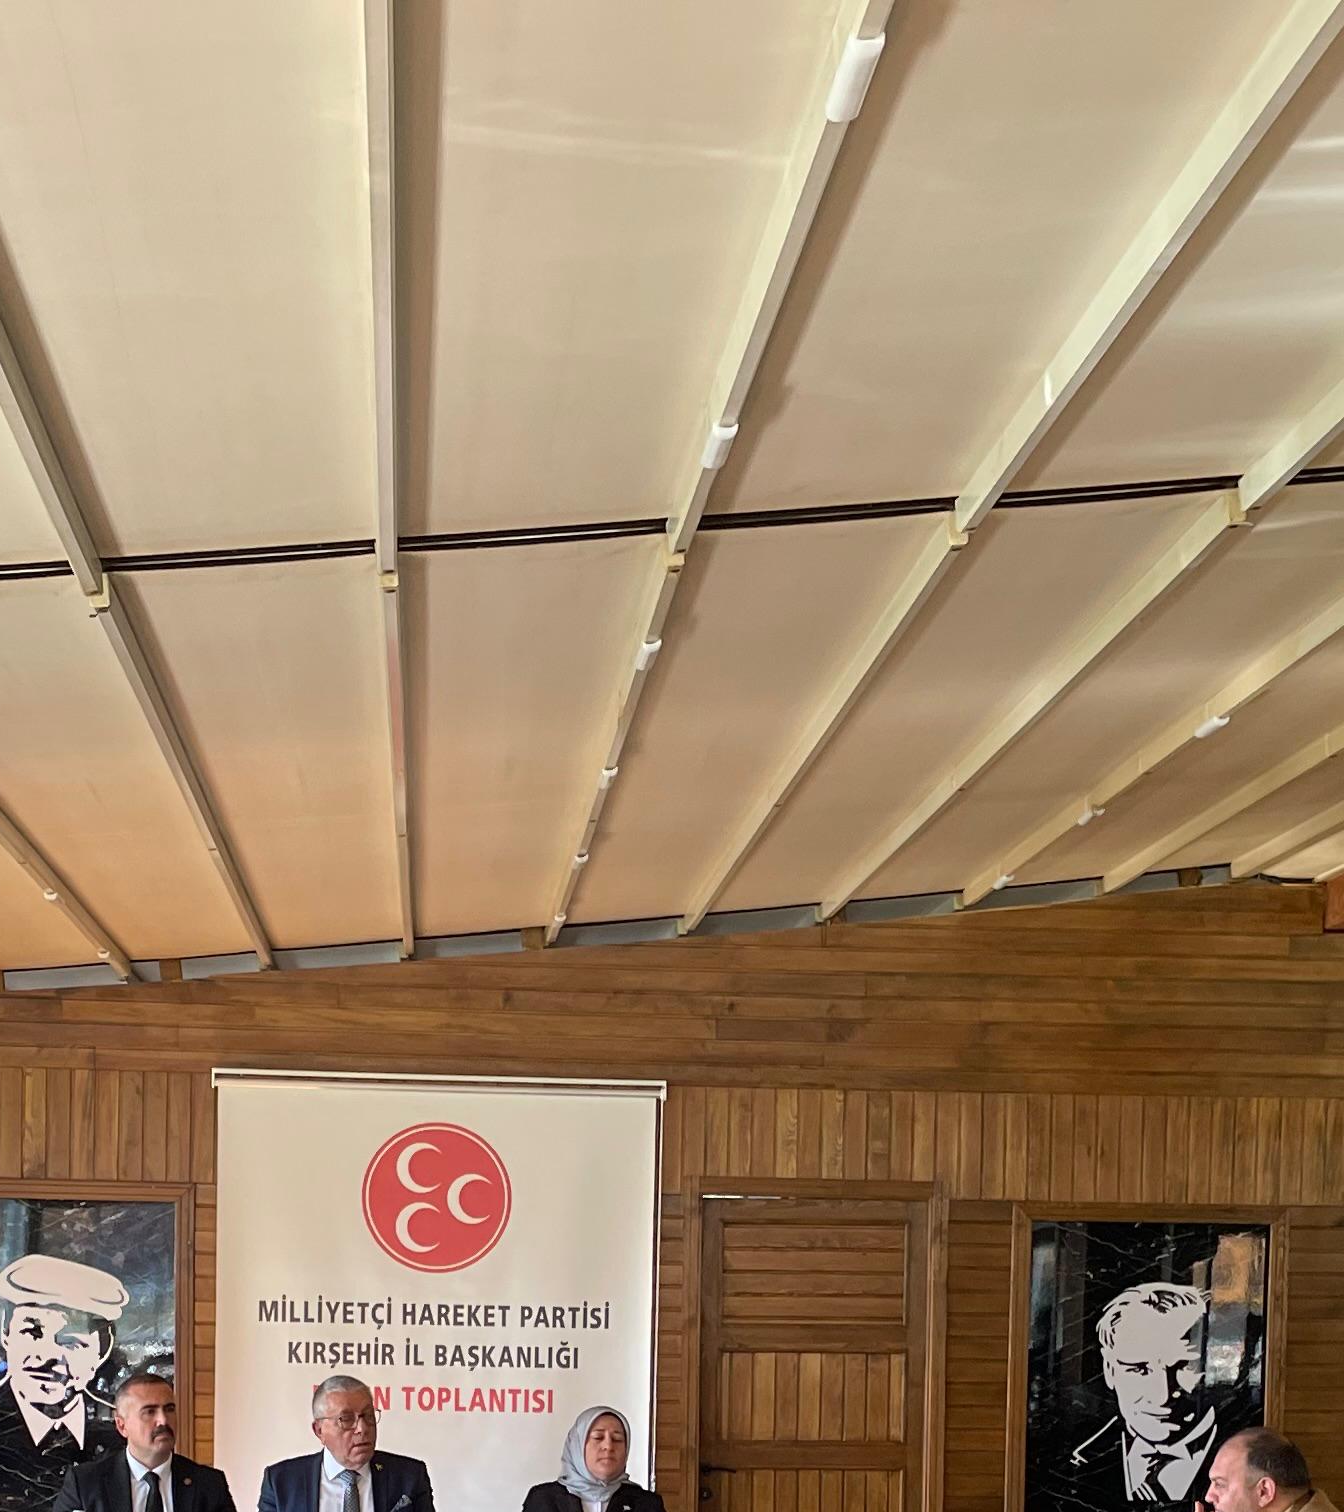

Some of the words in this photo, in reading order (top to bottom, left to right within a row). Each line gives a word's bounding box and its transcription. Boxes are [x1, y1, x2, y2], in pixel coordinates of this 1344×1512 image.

[258, 1294, 392, 1330] MİLLİYETÇİ
[402, 1303, 511, 1327] HAREKET
[520, 1301, 610, 1329] PARTİSİ
[287, 1337, 395, 1369] KIRŞEHİR
[405, 1338, 425, 1366] İL
[434, 1341, 579, 1372] BAŞKANLIĞI
[401, 1386, 554, 1414] TOPLANTISI
